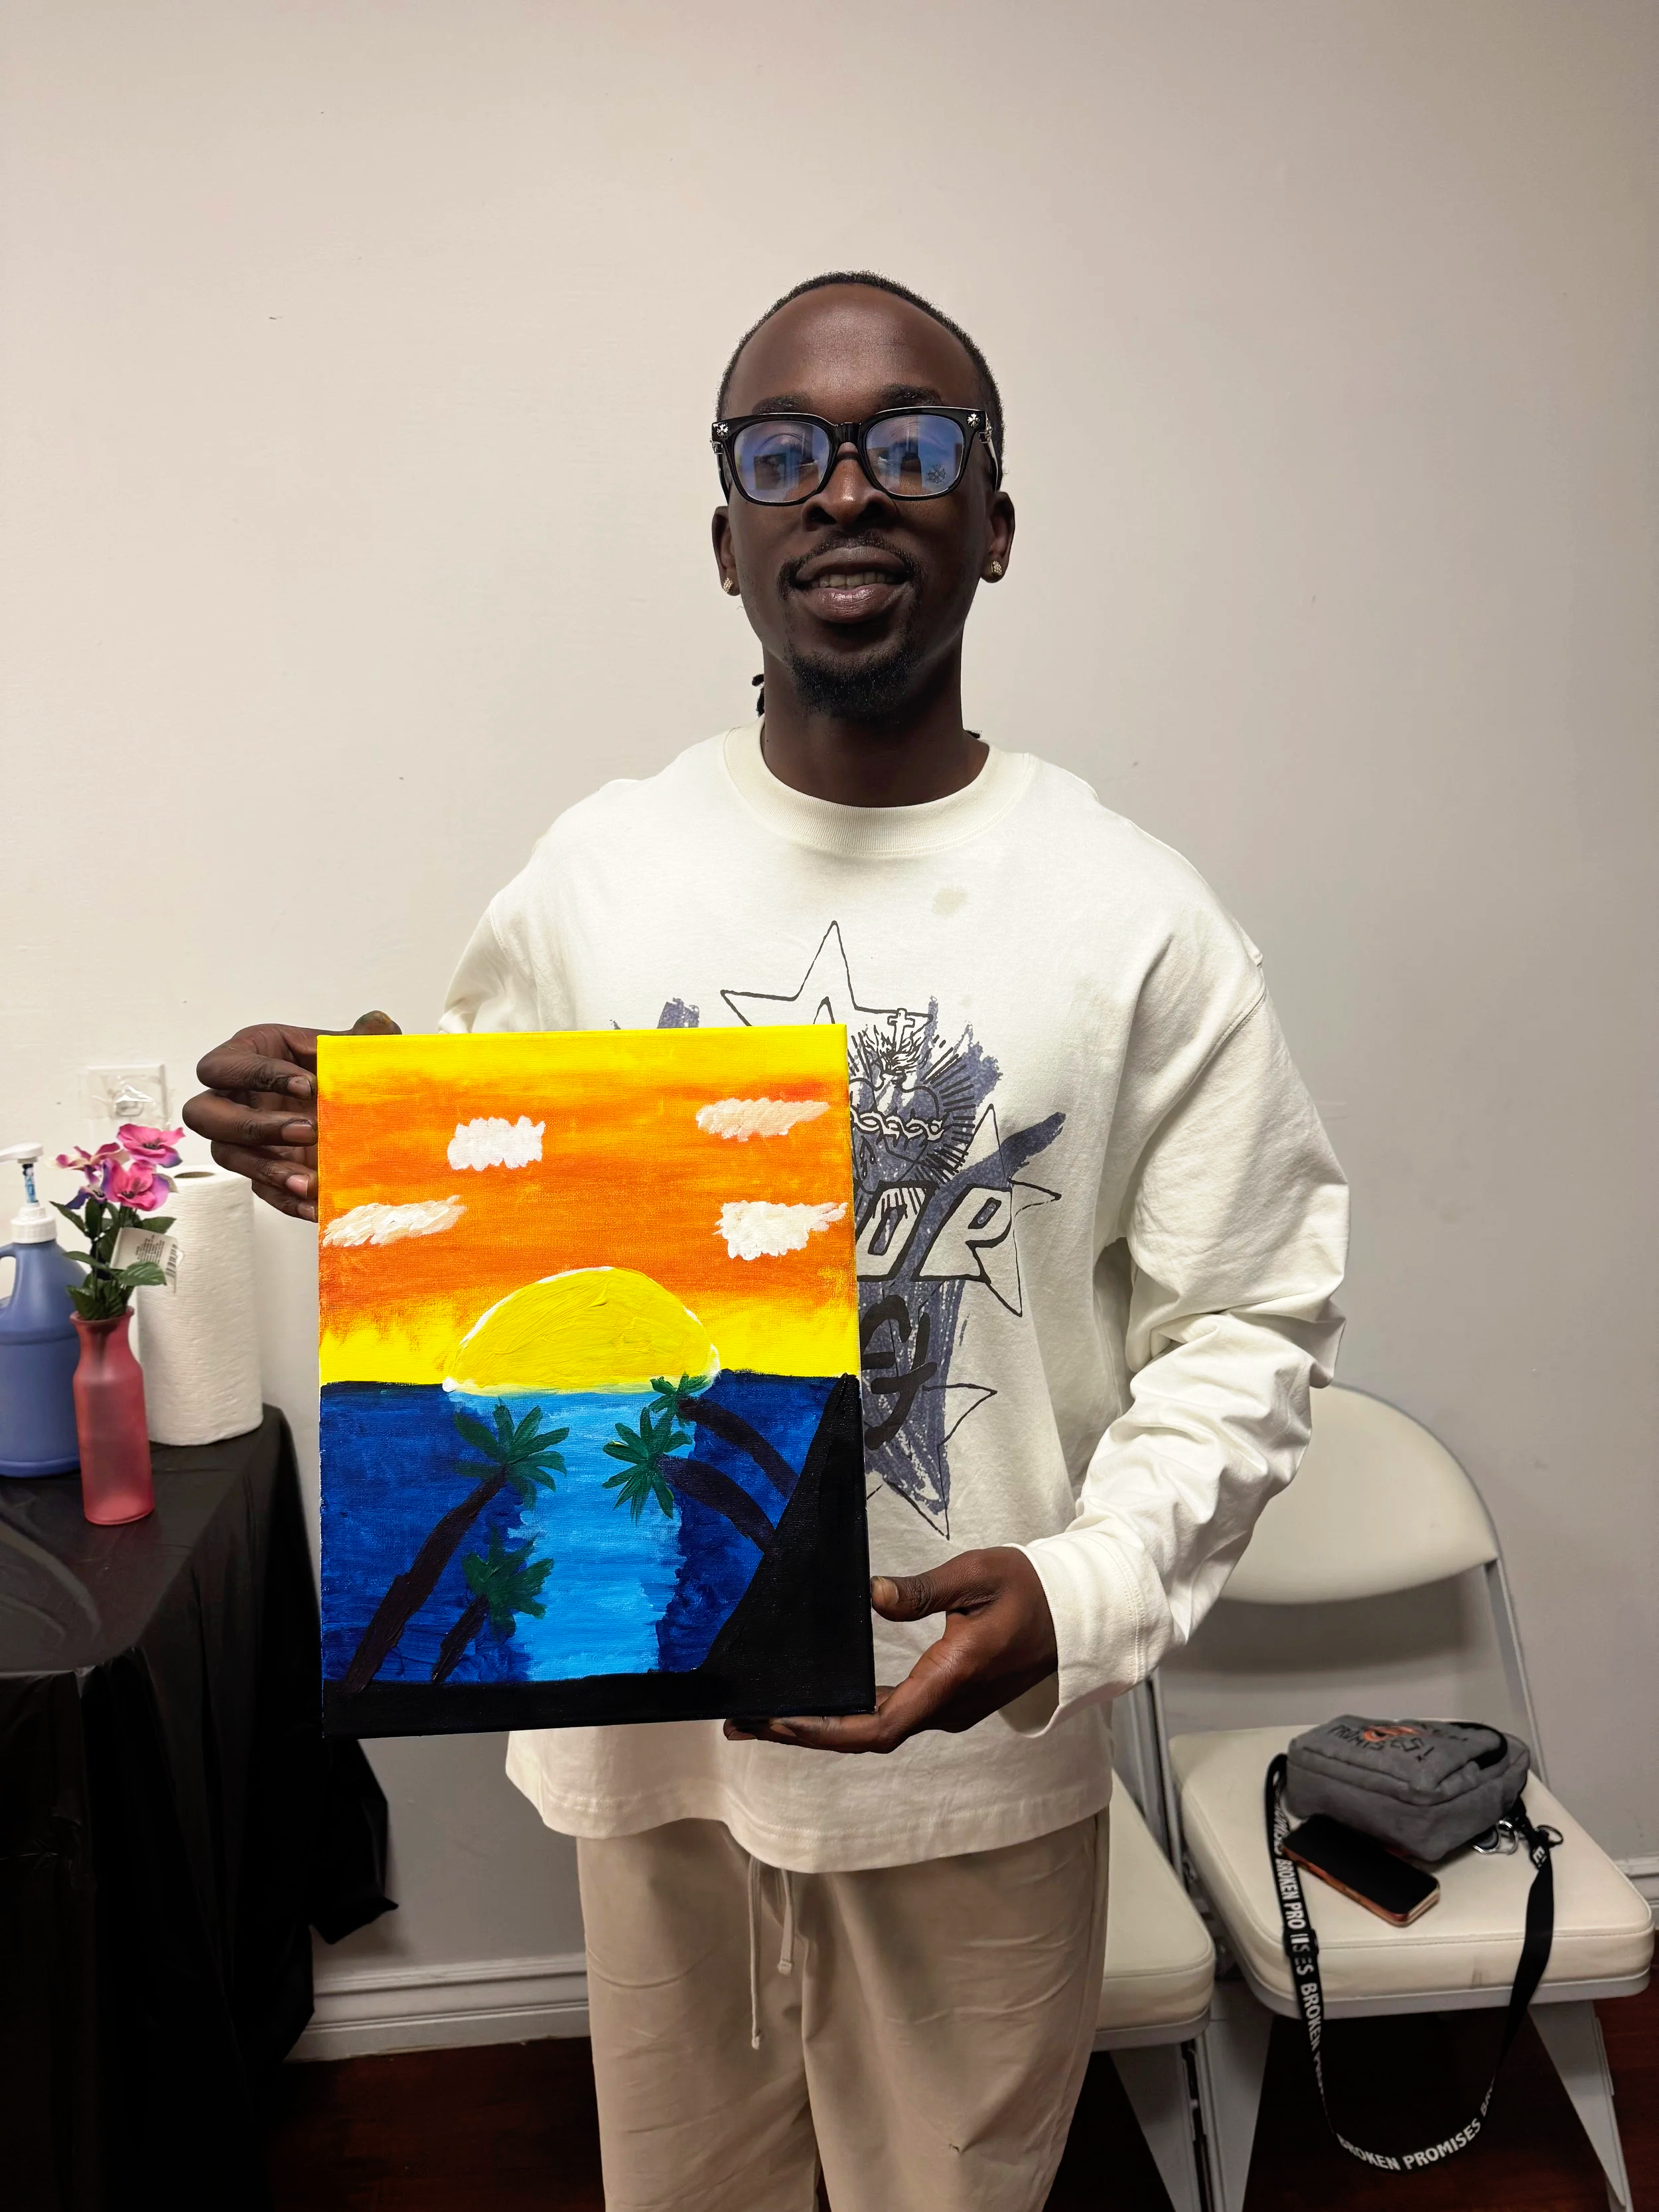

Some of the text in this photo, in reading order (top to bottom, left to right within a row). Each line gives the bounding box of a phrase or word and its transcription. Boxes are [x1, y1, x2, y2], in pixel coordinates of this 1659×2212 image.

[1275, 1858, 1301, 1900] BROKEN
[1301, 1982, 1321, 2052] BROKEN
[1402, 2118, 1481, 2170] PROMISES
